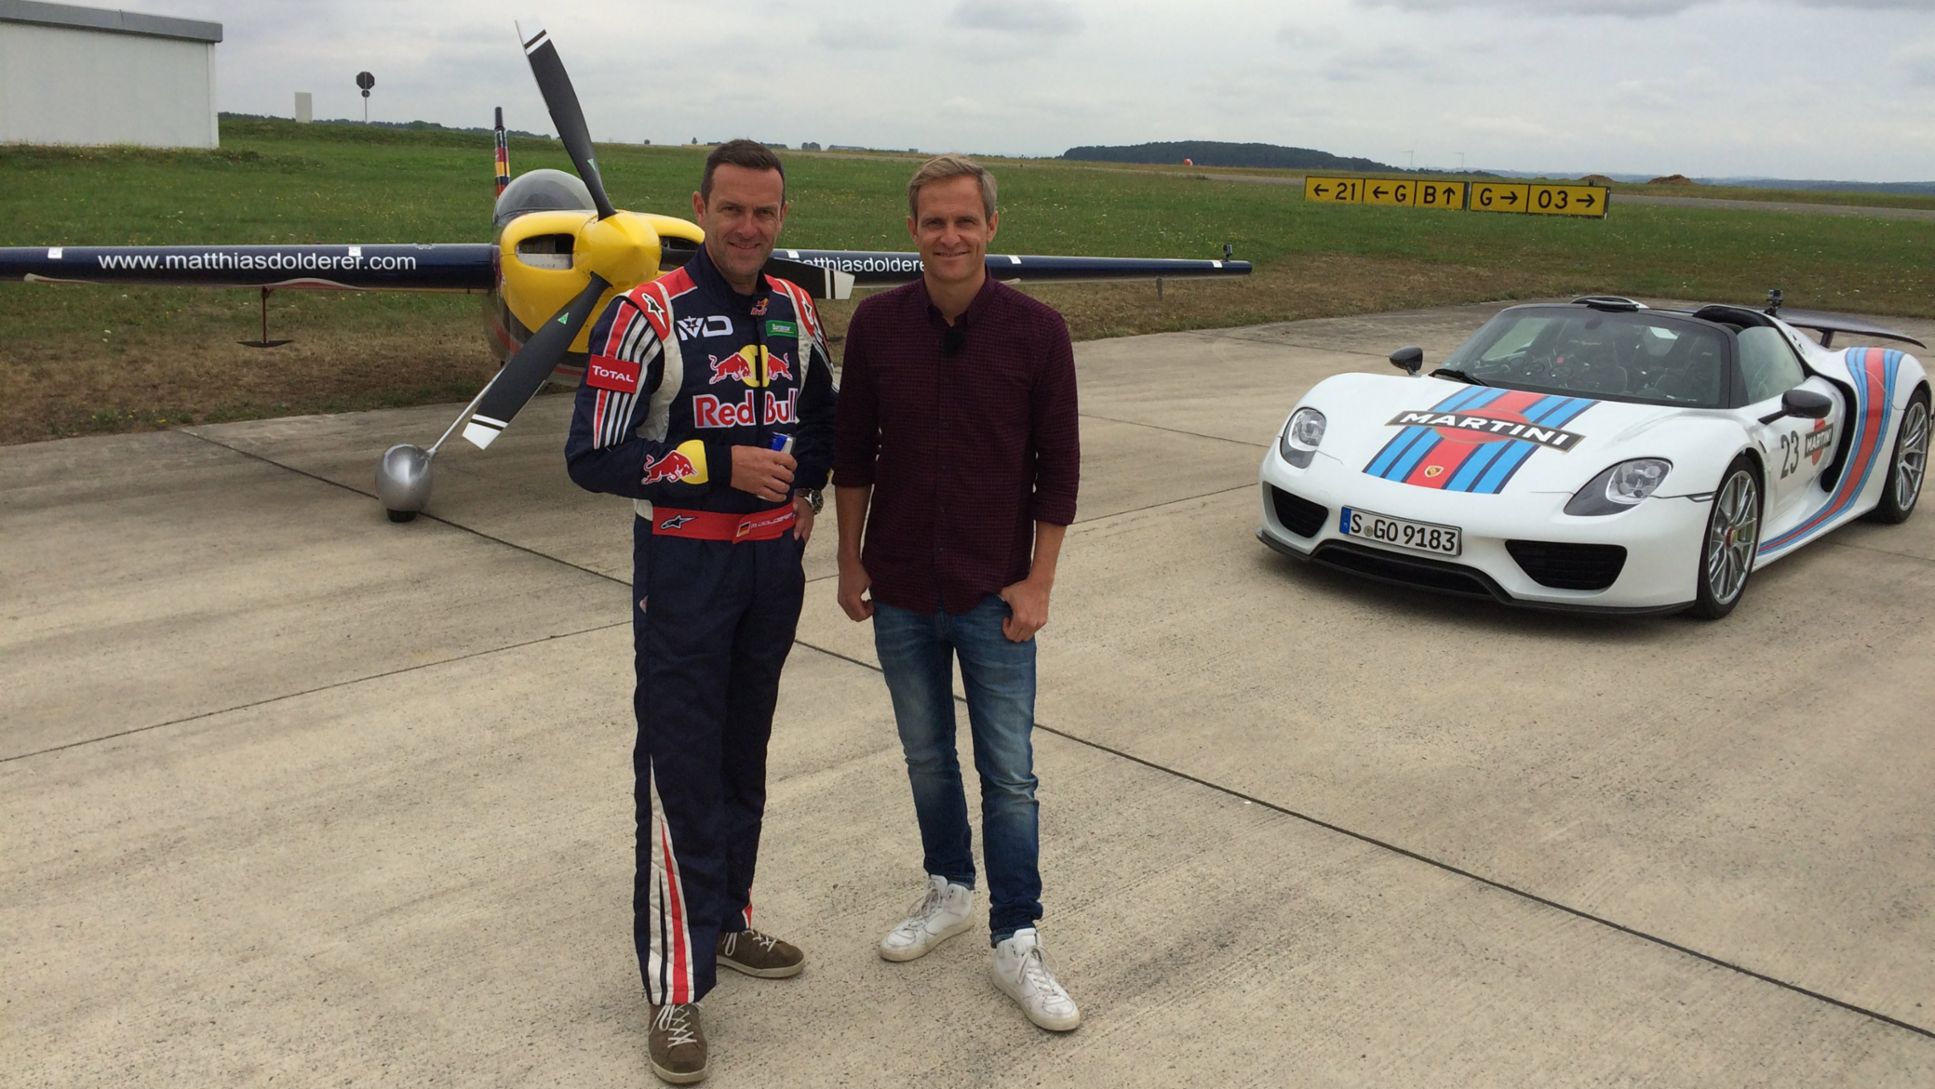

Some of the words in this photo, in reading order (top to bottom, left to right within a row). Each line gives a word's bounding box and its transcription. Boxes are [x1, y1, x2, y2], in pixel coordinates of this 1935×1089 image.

[1336, 182, 1355, 201] 21
[1394, 184, 1406, 202] G
[1423, 186, 1436, 204] B
[1480, 188, 1492, 206] G
[1537, 190, 1568, 209] 03
[98, 252, 417, 270] www.matthiasdolderer.com
[793, 256, 925, 272] tthiasdolder
[592, 365, 635, 384] TOTAL
[693, 389, 755, 428] Red
[763, 387, 799, 426] Bull
[1400, 412, 1568, 446] MARTINI
[1780, 430, 1799, 479] 23
[1351, 514, 1362, 533] S
[1374, 519, 1398, 542] GO
[1404, 525, 1457, 553] 9183
